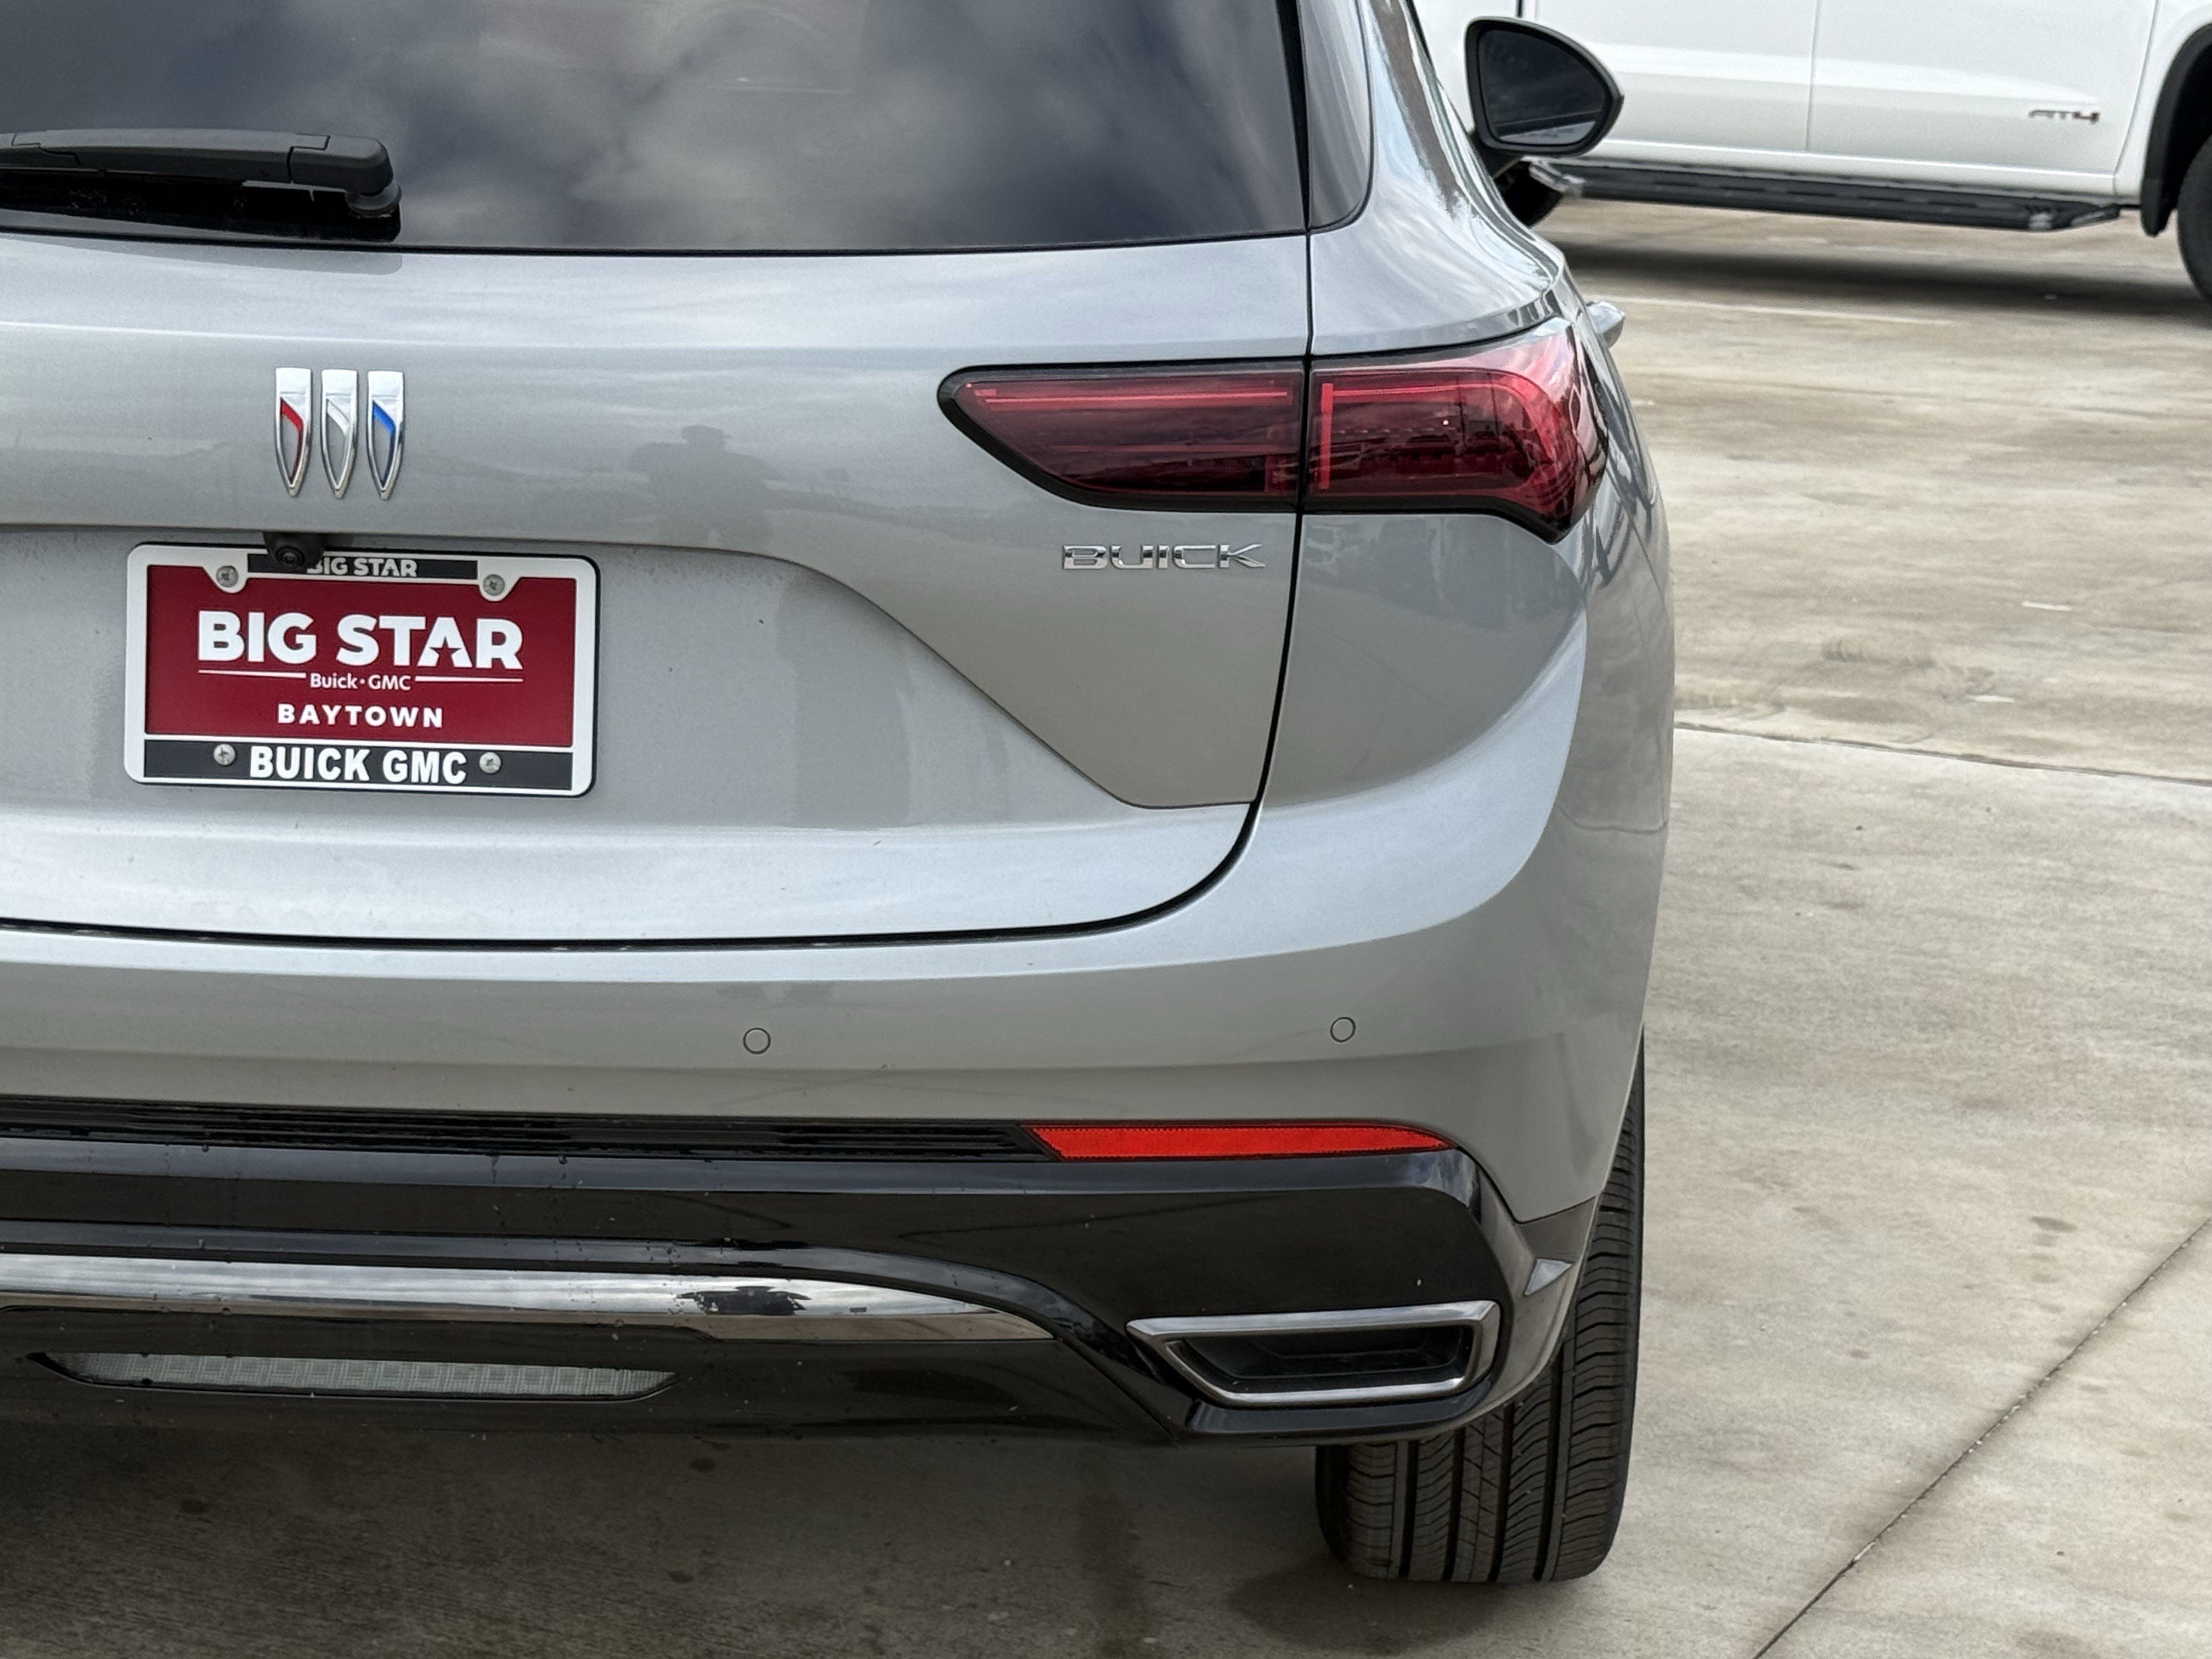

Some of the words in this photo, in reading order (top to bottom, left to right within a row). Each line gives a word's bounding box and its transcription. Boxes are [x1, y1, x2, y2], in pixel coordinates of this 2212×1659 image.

[353, 557, 417, 577] STAR
[1063, 544, 1266, 569] BUICK
[198, 610, 317, 664] BIG
[336, 613, 523, 669] STAR
[310, 673, 358, 689] Buick
[368, 675, 411, 691] GMC
[277, 703, 443, 728] BAYTOWN
[250, 746, 370, 781] BUICK
[383, 749, 467, 785] GMC
